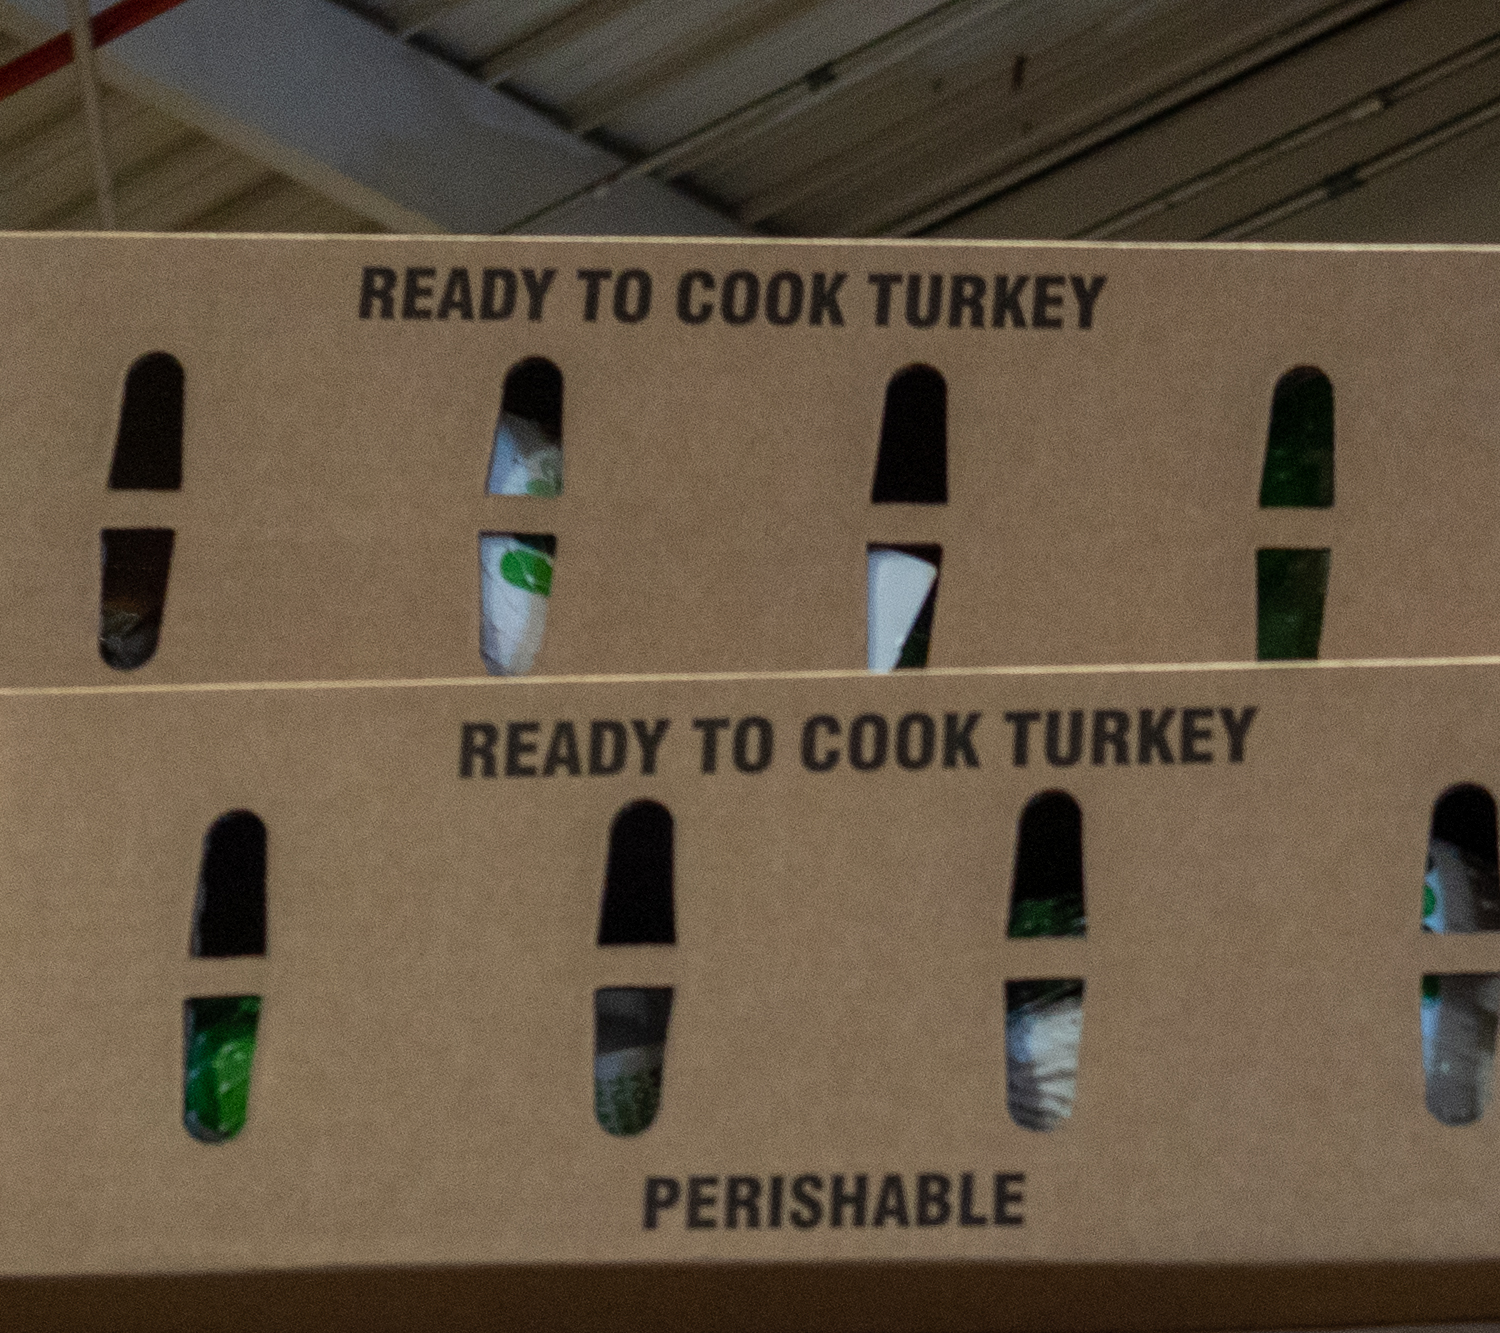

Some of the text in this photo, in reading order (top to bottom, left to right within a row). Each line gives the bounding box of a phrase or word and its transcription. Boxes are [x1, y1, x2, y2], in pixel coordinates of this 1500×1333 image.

[358, 265, 1108, 330] READY TO COOK TURKEY
[458, 706, 1260, 779] READY TO COOK TURKEY
[642, 1171, 1029, 1233] PERISHABLE
